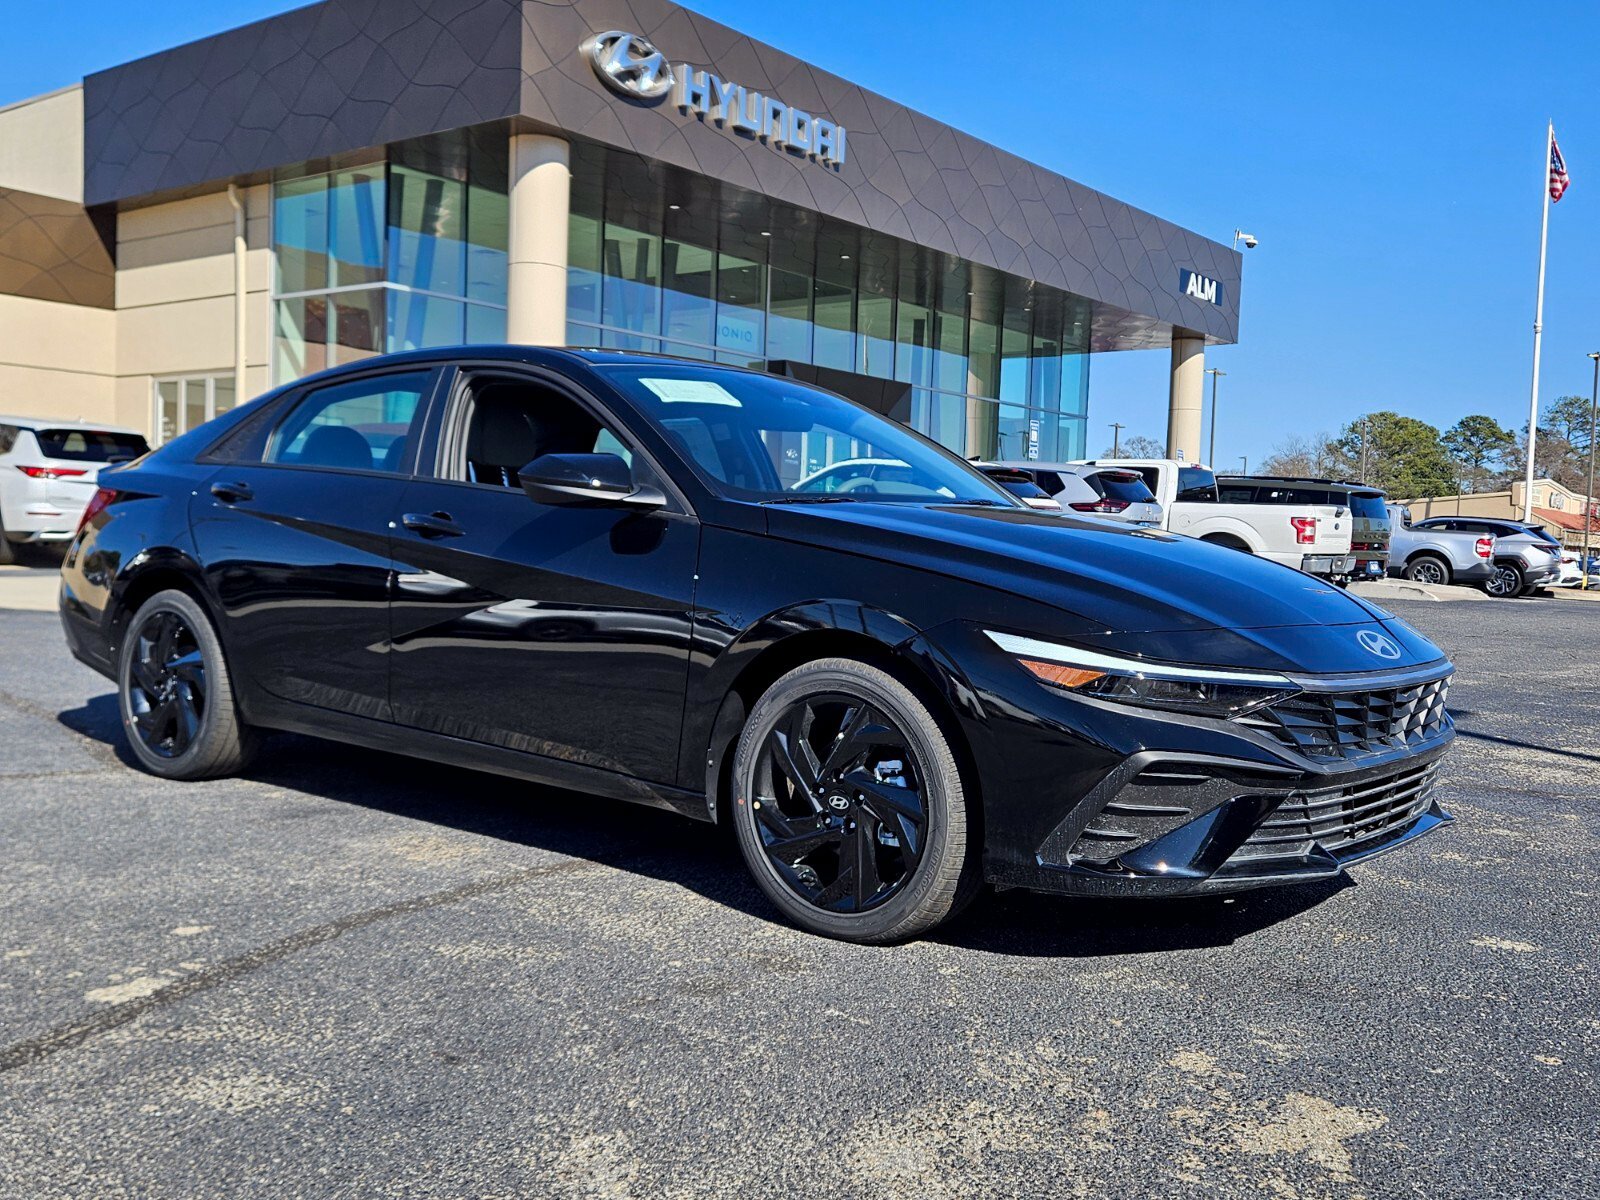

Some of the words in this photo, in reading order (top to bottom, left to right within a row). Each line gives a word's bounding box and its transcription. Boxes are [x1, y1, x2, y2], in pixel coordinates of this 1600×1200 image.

[676, 63, 846, 164] HYUNDAI
[1186, 272, 1217, 304] ALM
[717, 325, 753, 343] IONIQ
